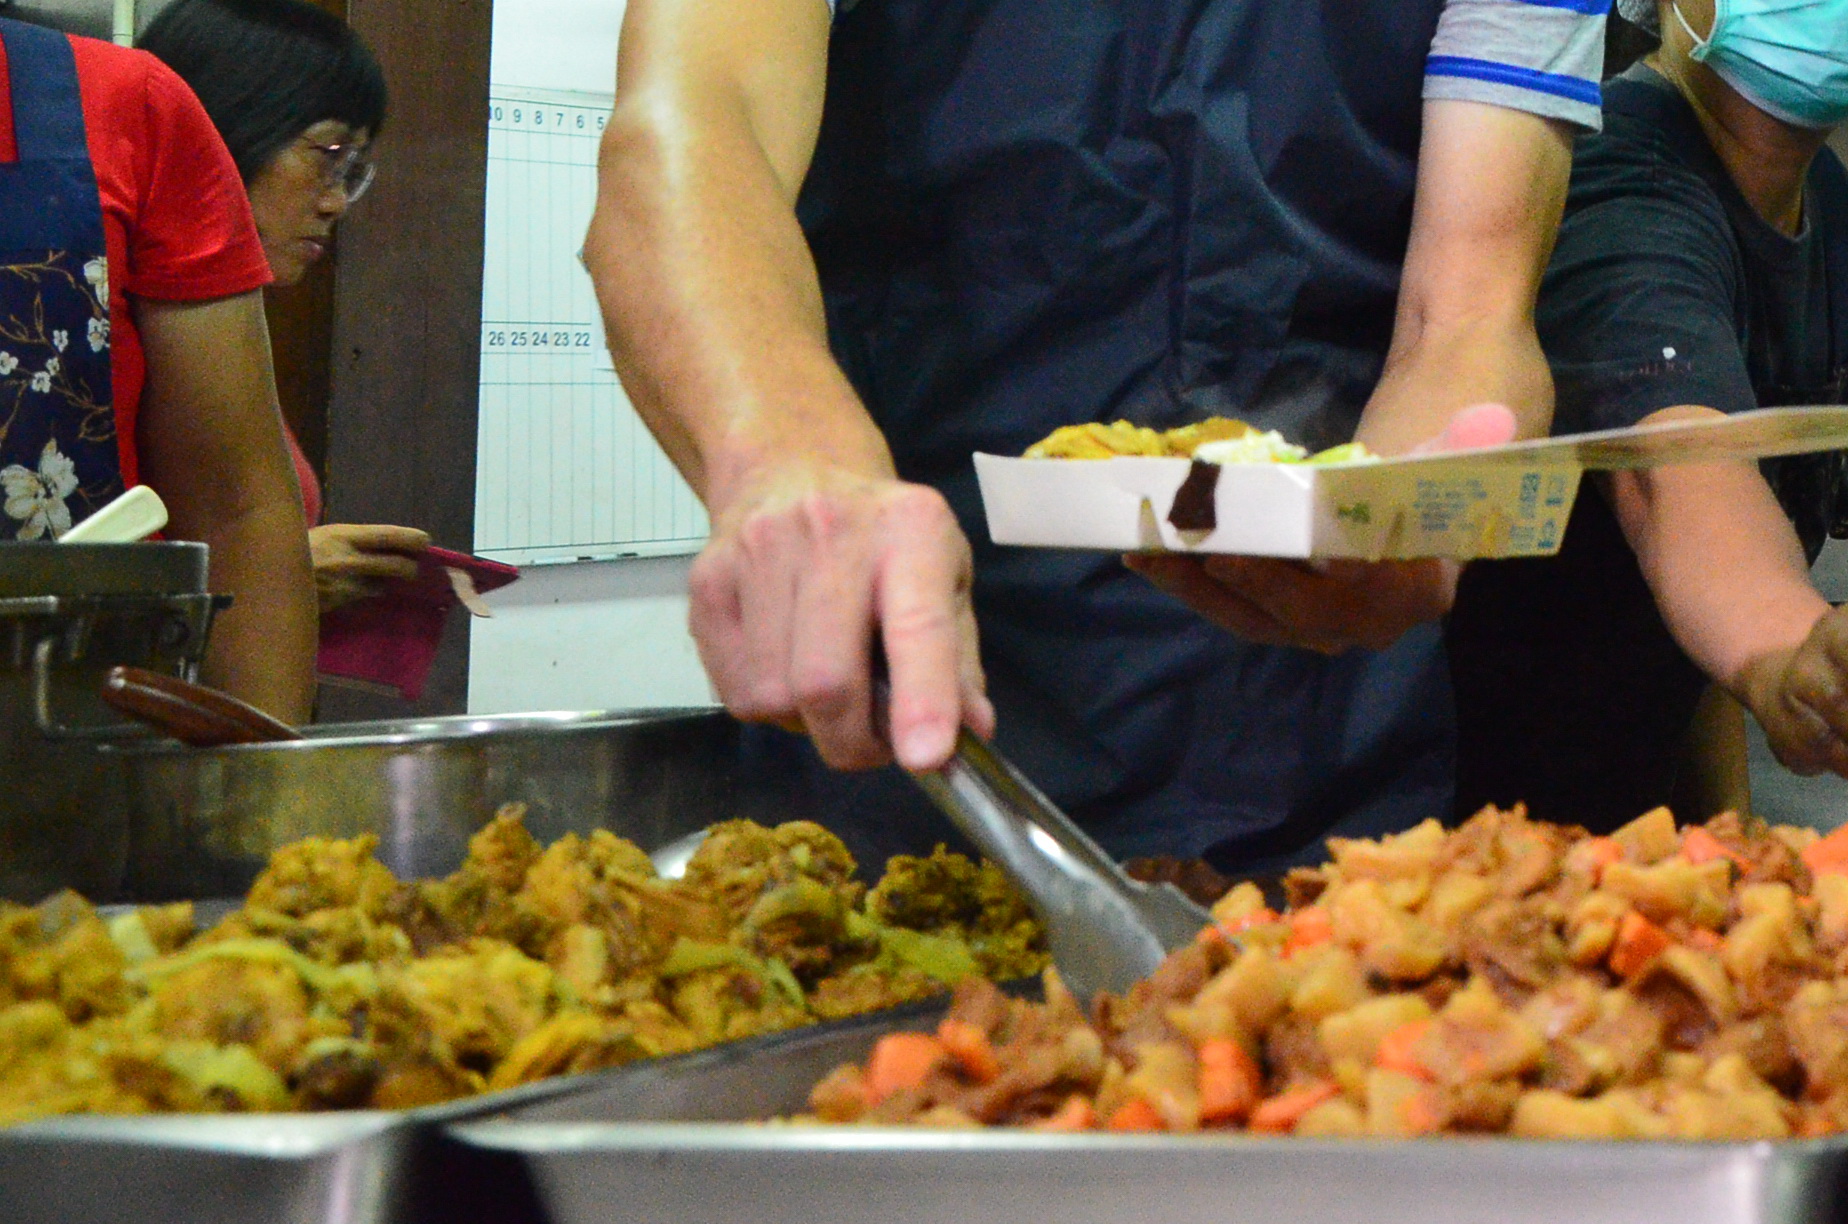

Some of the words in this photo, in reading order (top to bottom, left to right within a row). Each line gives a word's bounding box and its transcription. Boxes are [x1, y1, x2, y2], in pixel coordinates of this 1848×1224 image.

[513, 109, 521, 123] 9
[535, 110, 543, 125] 8
[556, 112, 564, 127] 7
[576, 114, 584, 129] 6
[597, 116, 604, 130] 5
[489, 331, 505, 346] 26
[511, 331, 527, 346] 25
[532, 331, 548, 346] 24
[554, 332, 570, 347] 23
[575, 332, 590, 347] 22
